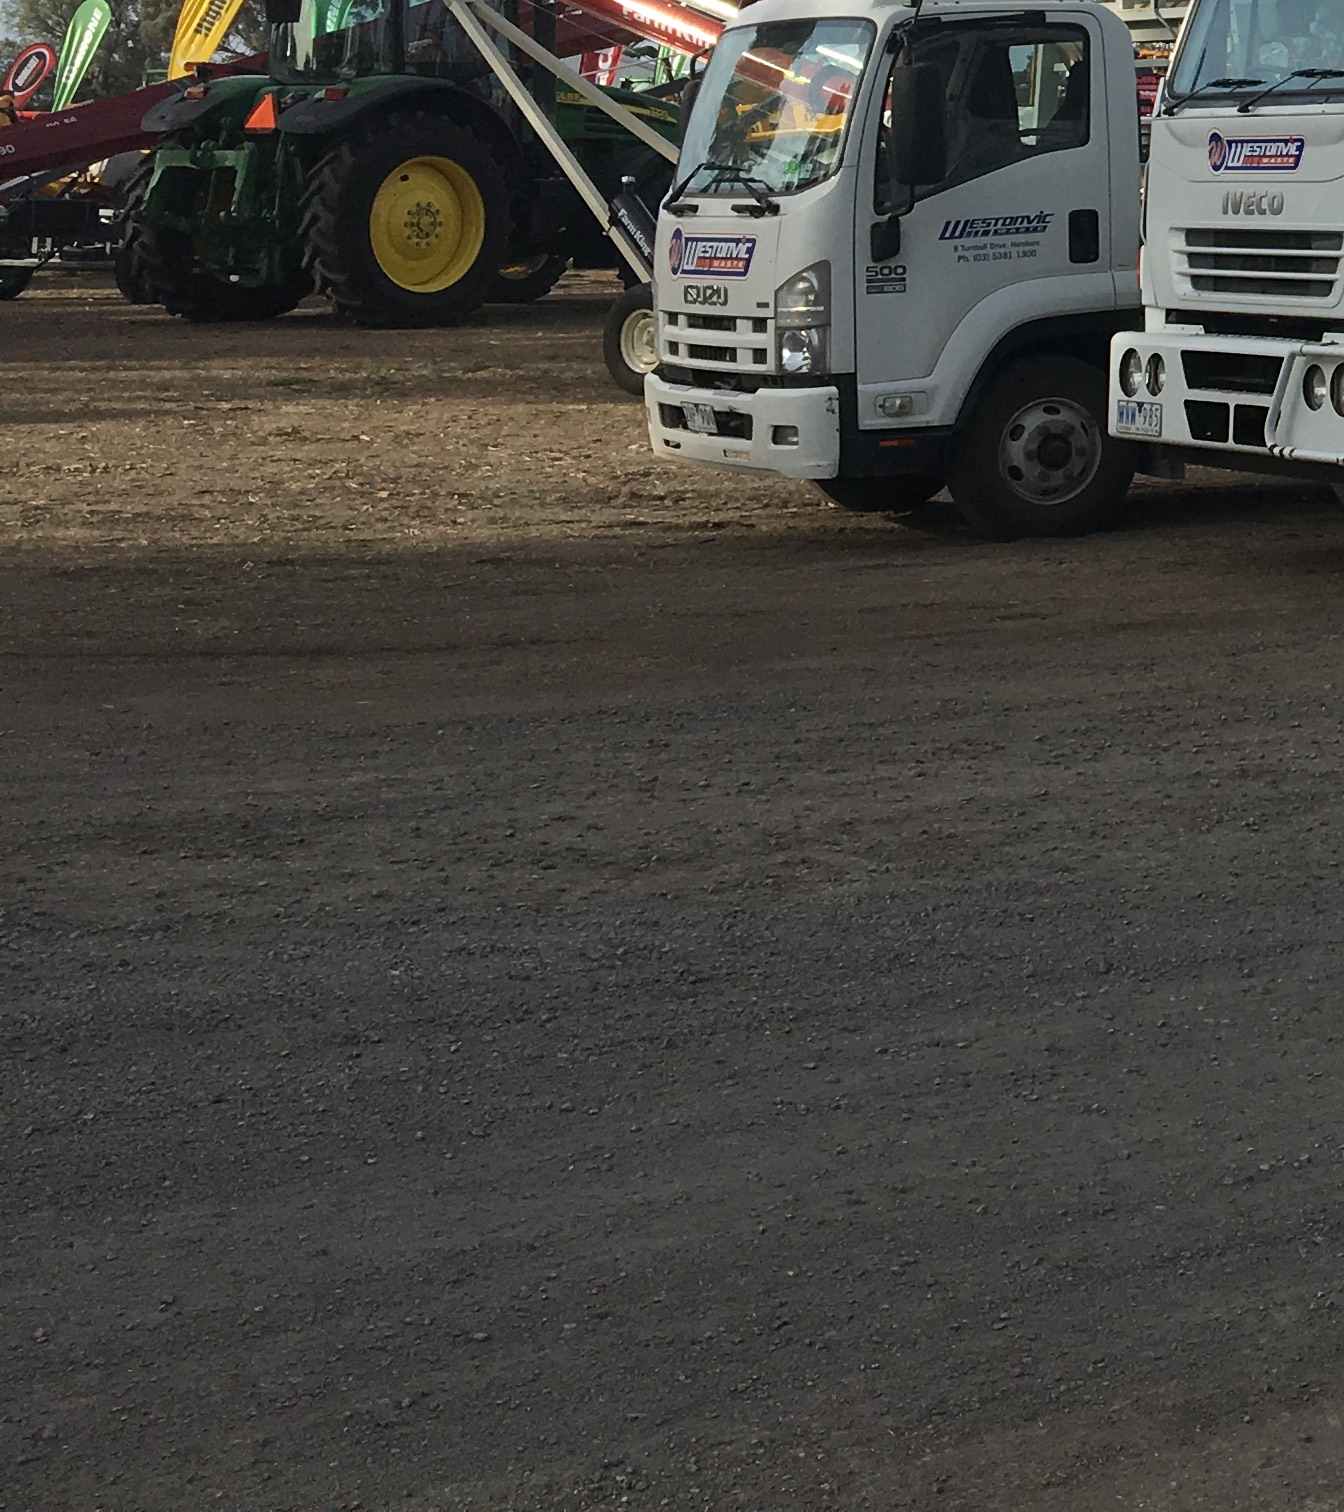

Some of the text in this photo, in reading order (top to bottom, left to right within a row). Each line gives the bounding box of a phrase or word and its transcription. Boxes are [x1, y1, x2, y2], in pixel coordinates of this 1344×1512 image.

[1222, 190, 1284, 216] IVECO
[1016, 249, 1037, 259] 1300
[866, 265, 907, 277] 500
[1143, 407, 1160, 427] 985
